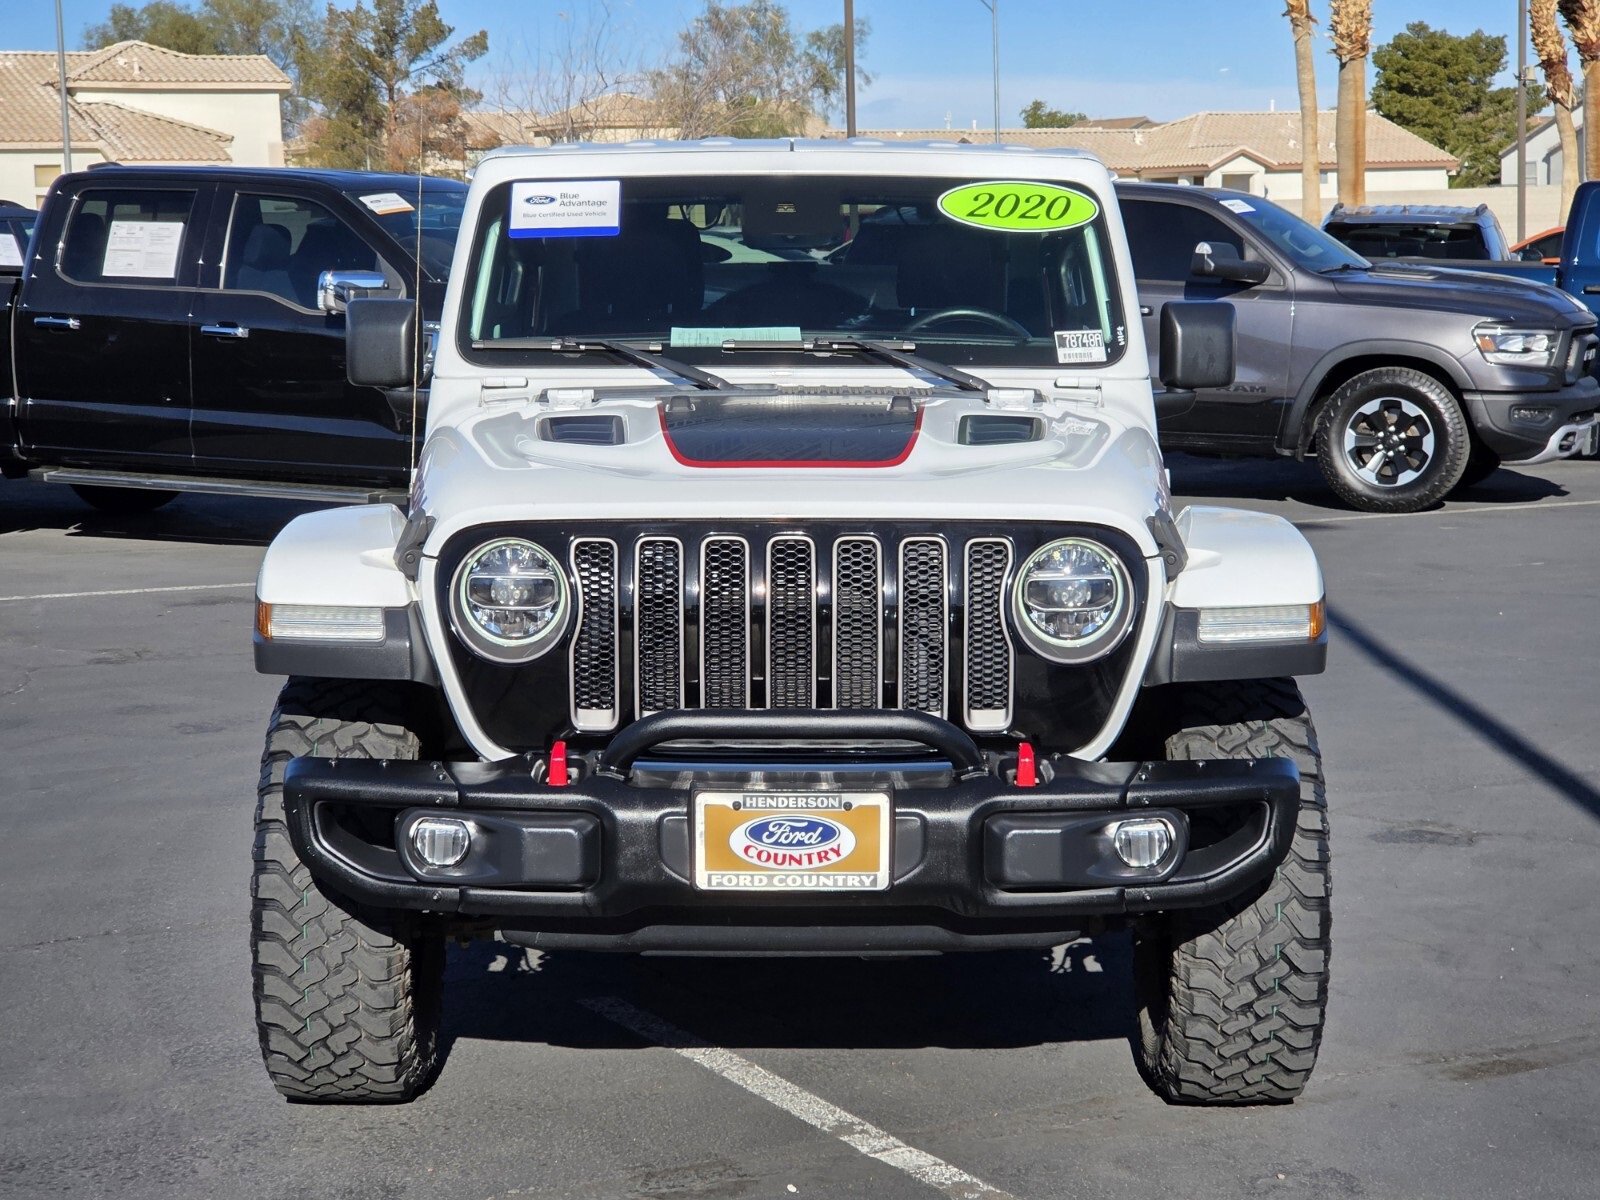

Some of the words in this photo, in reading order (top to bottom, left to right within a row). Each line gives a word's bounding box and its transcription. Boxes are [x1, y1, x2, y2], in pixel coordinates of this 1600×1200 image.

[560, 192, 580, 200] Blue
[966, 192, 1071, 221] 2020
[1062, 333, 1103, 348] 78748A
[745, 796, 840, 809] HENDERSON
[762, 820, 823, 844] Ford
[743, 843, 843, 867] COUNTRY
[711, 875, 768, 888] FORD
[773, 874, 875, 888] COUNTRY
